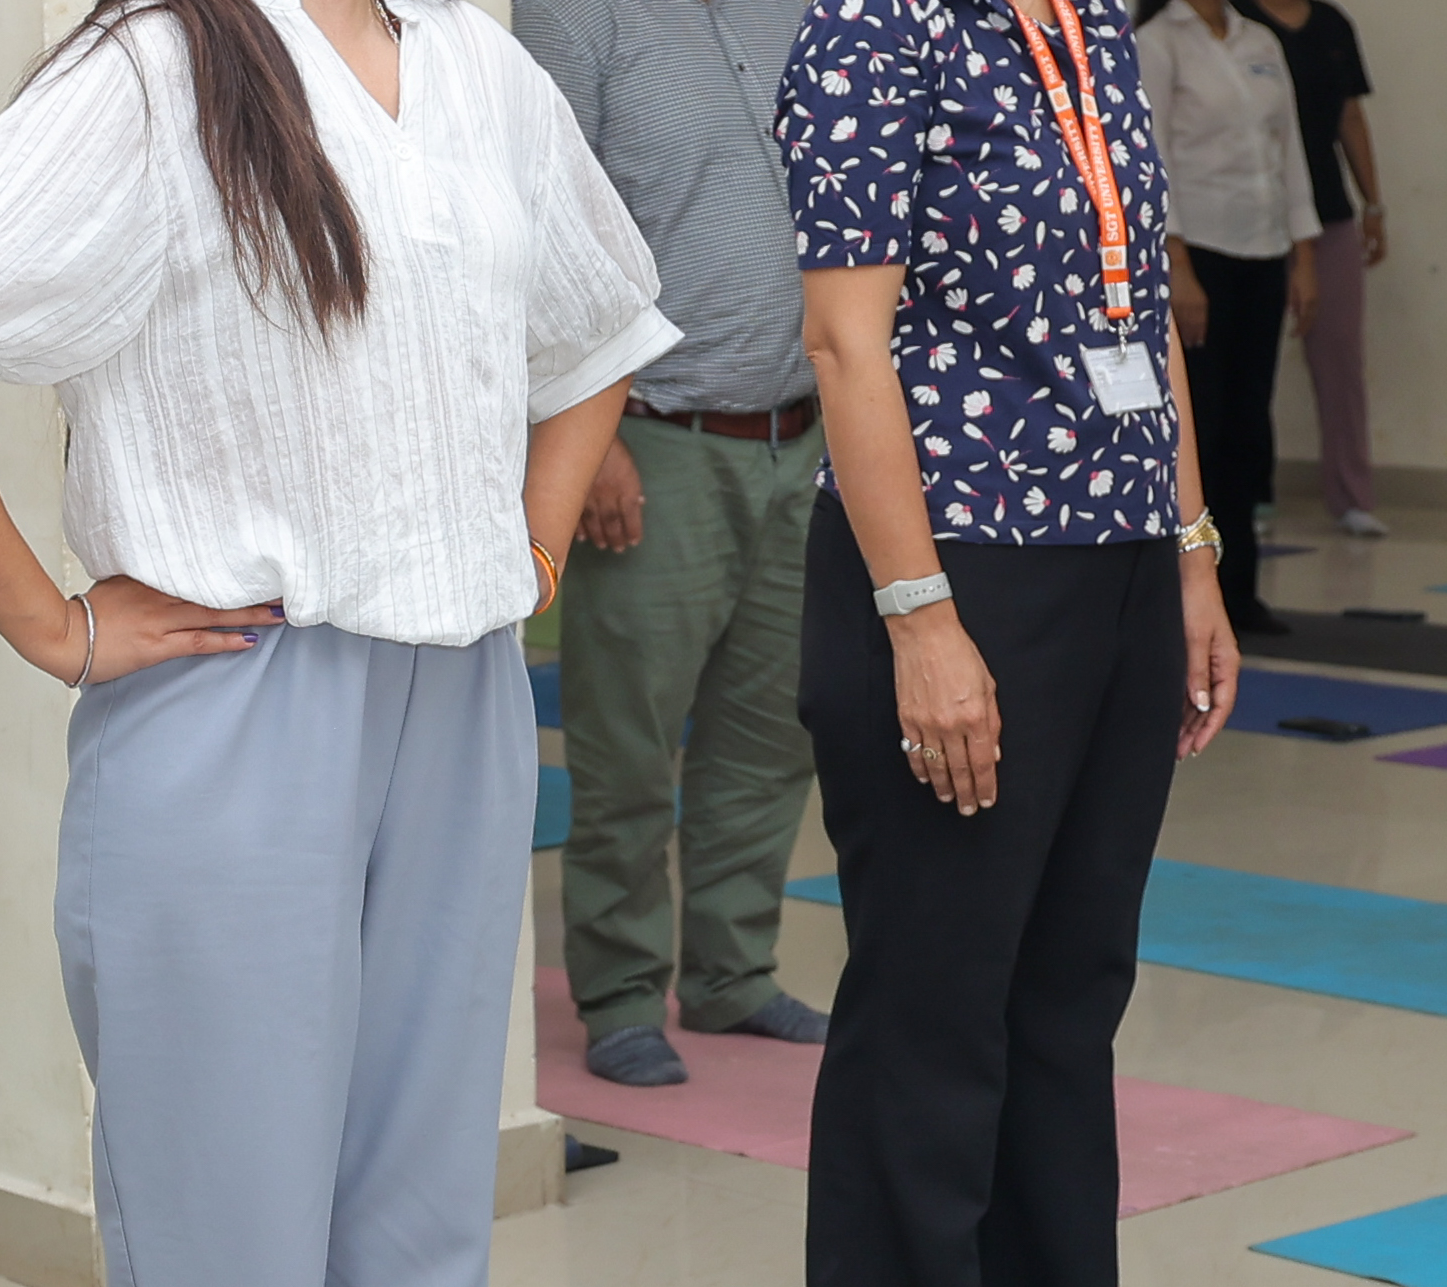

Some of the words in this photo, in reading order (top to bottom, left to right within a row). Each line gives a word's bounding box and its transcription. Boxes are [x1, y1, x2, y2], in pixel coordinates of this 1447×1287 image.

[1040, 54, 1058, 84] SGT
[1088, 122, 1114, 208] UNIVERSITY
[1105, 211, 1119, 242] SGT
